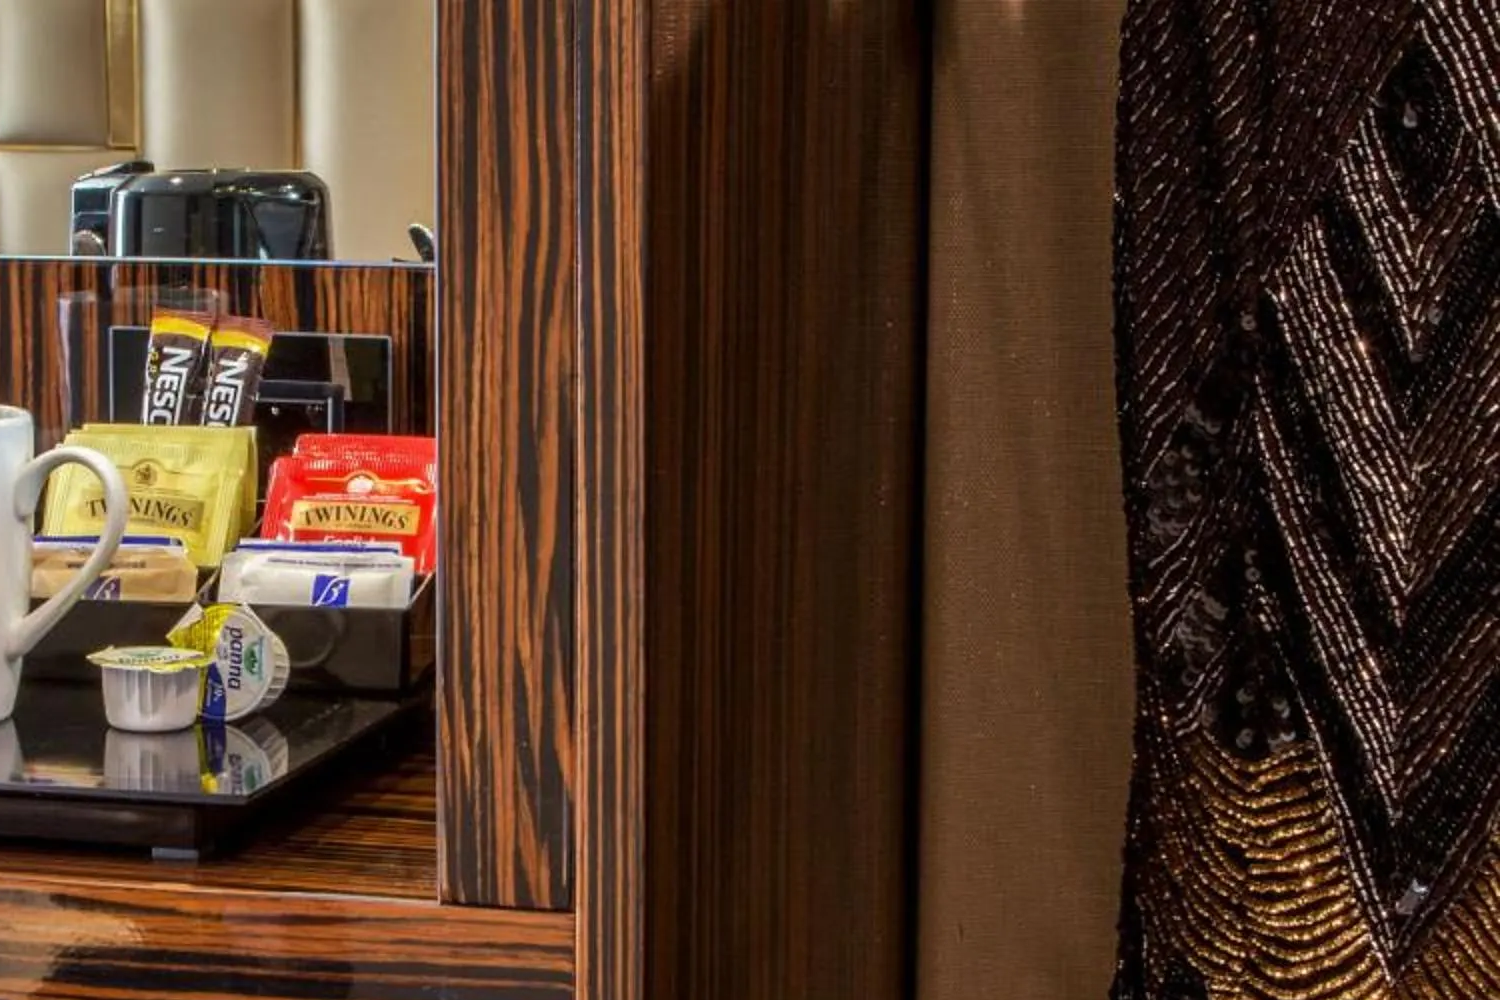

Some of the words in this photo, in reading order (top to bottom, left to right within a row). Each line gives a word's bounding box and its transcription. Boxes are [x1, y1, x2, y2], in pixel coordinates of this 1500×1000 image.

[207, 358, 248, 428] NES
[301, 504, 409, 529] TWININGS
[225, 626, 243, 690] panna
